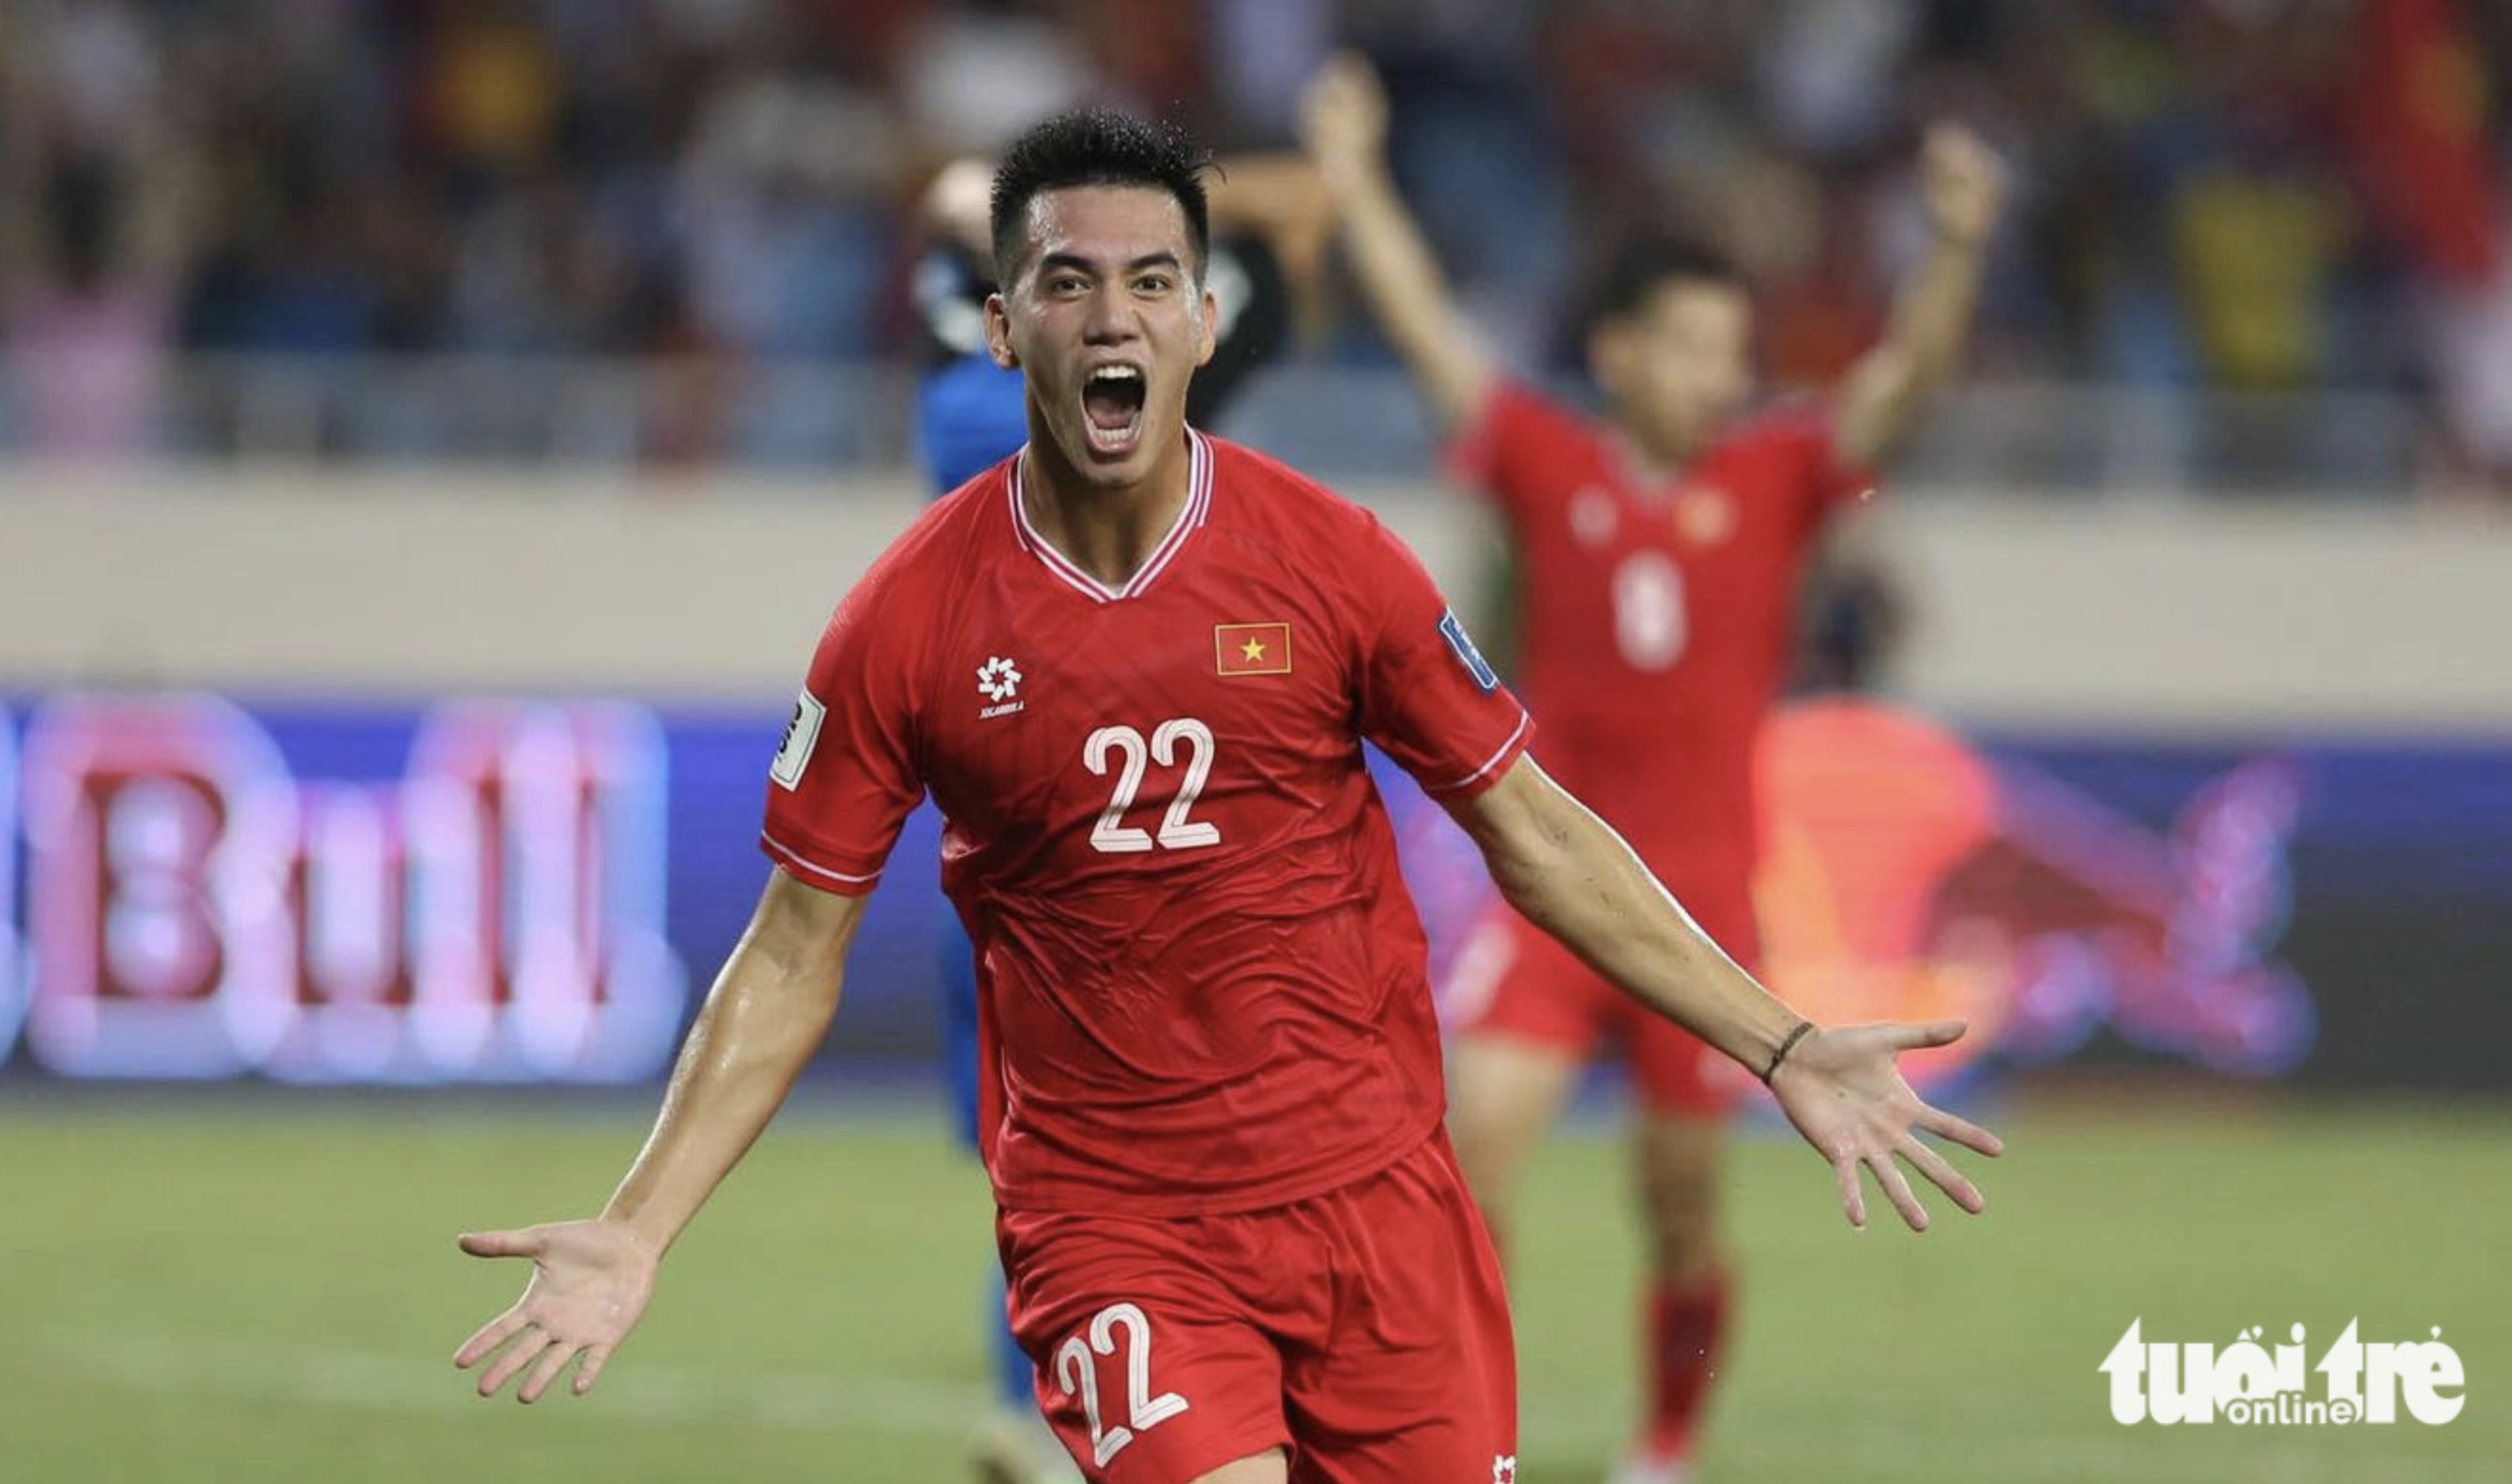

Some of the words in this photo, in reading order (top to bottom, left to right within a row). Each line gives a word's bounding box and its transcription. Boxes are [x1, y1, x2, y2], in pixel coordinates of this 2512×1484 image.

[1083, 717, 1221, 852] 22
[27, 695, 682, 1079] Bull
[1057, 1303, 1189, 1468] 22
